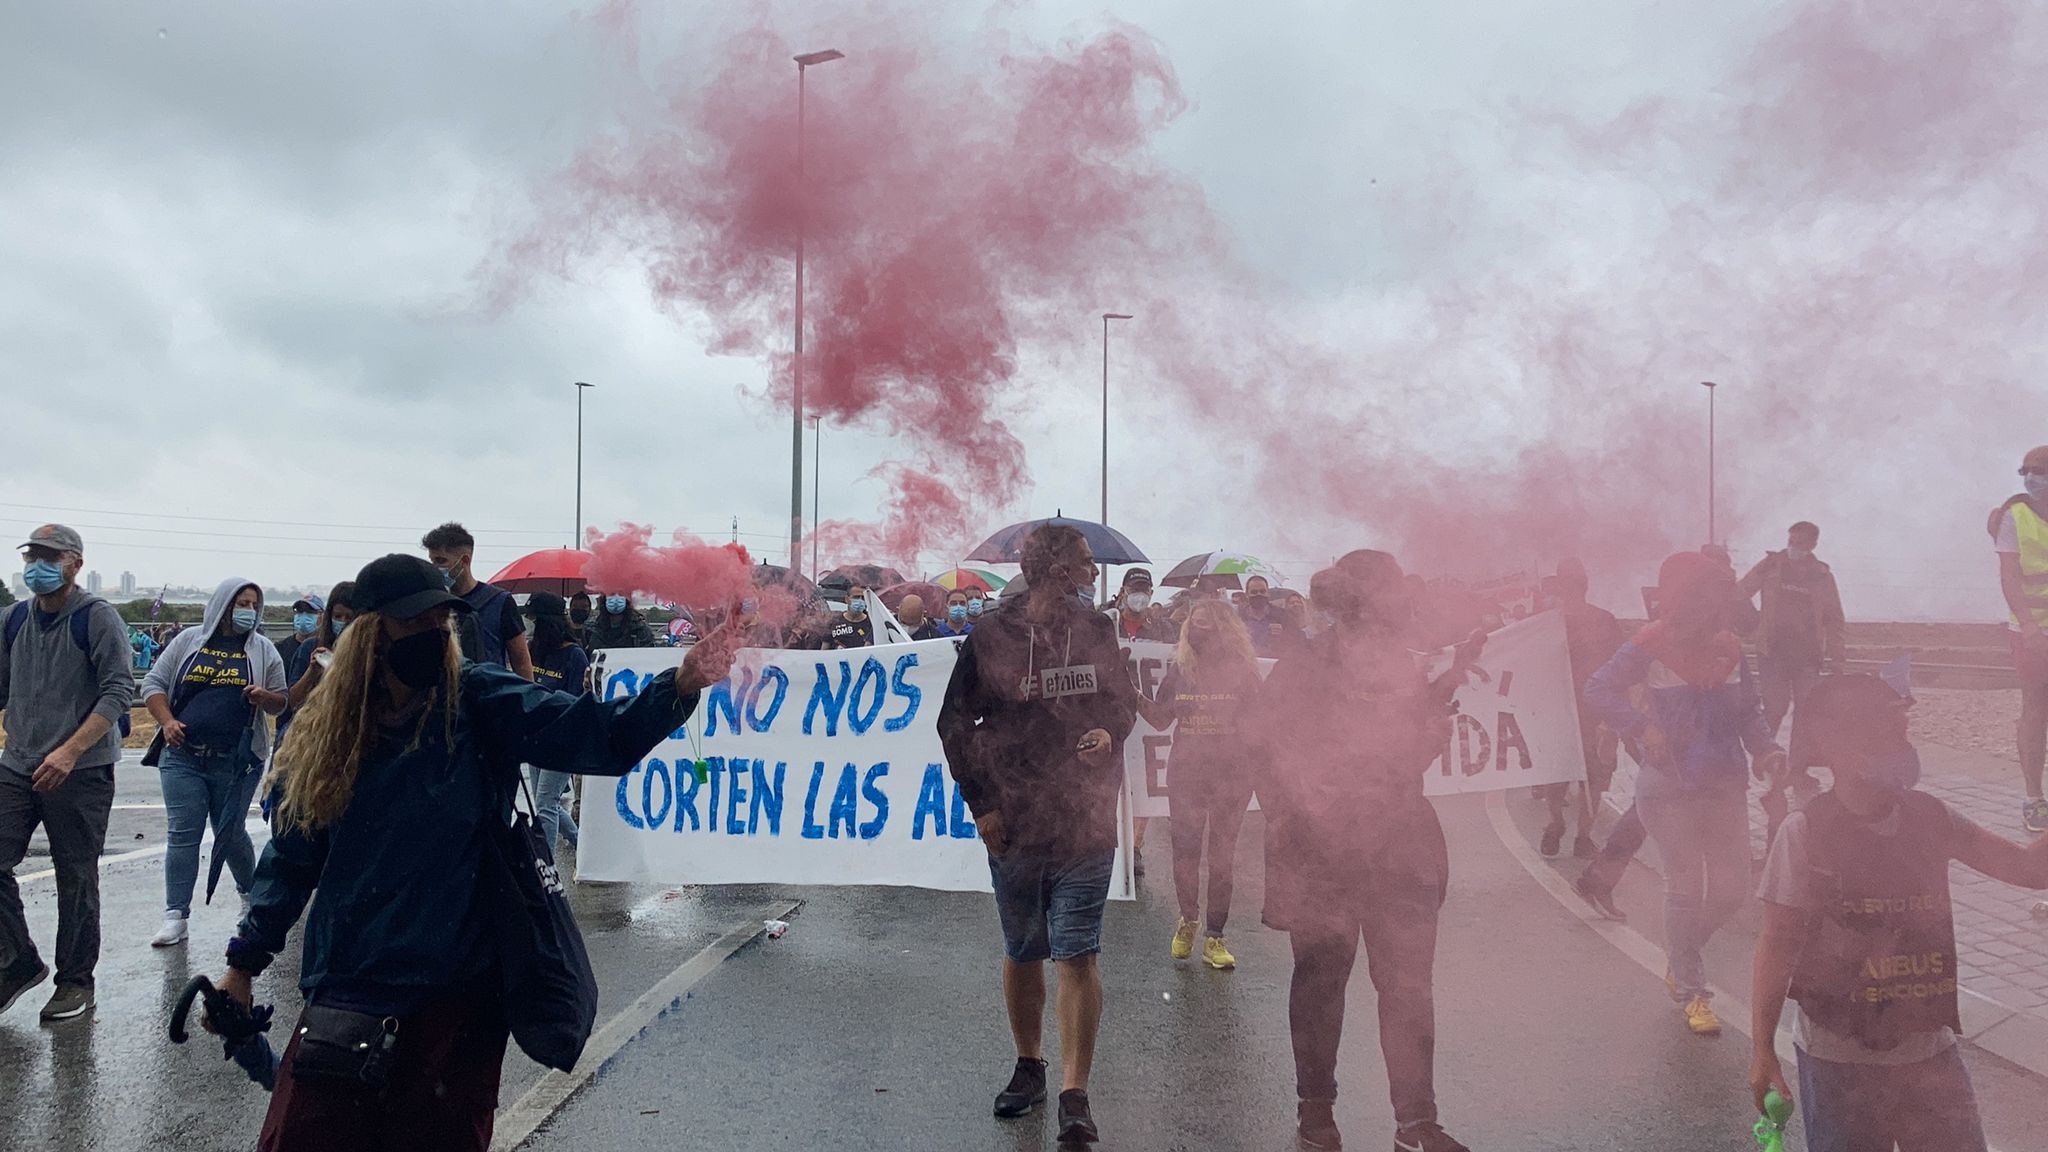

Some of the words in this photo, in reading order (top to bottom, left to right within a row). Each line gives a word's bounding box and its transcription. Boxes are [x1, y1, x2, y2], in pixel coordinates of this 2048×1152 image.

[802, 653, 922, 737] NOS
[616, 756, 787, 837] CORTEN
[801, 762, 890, 840] LAS
